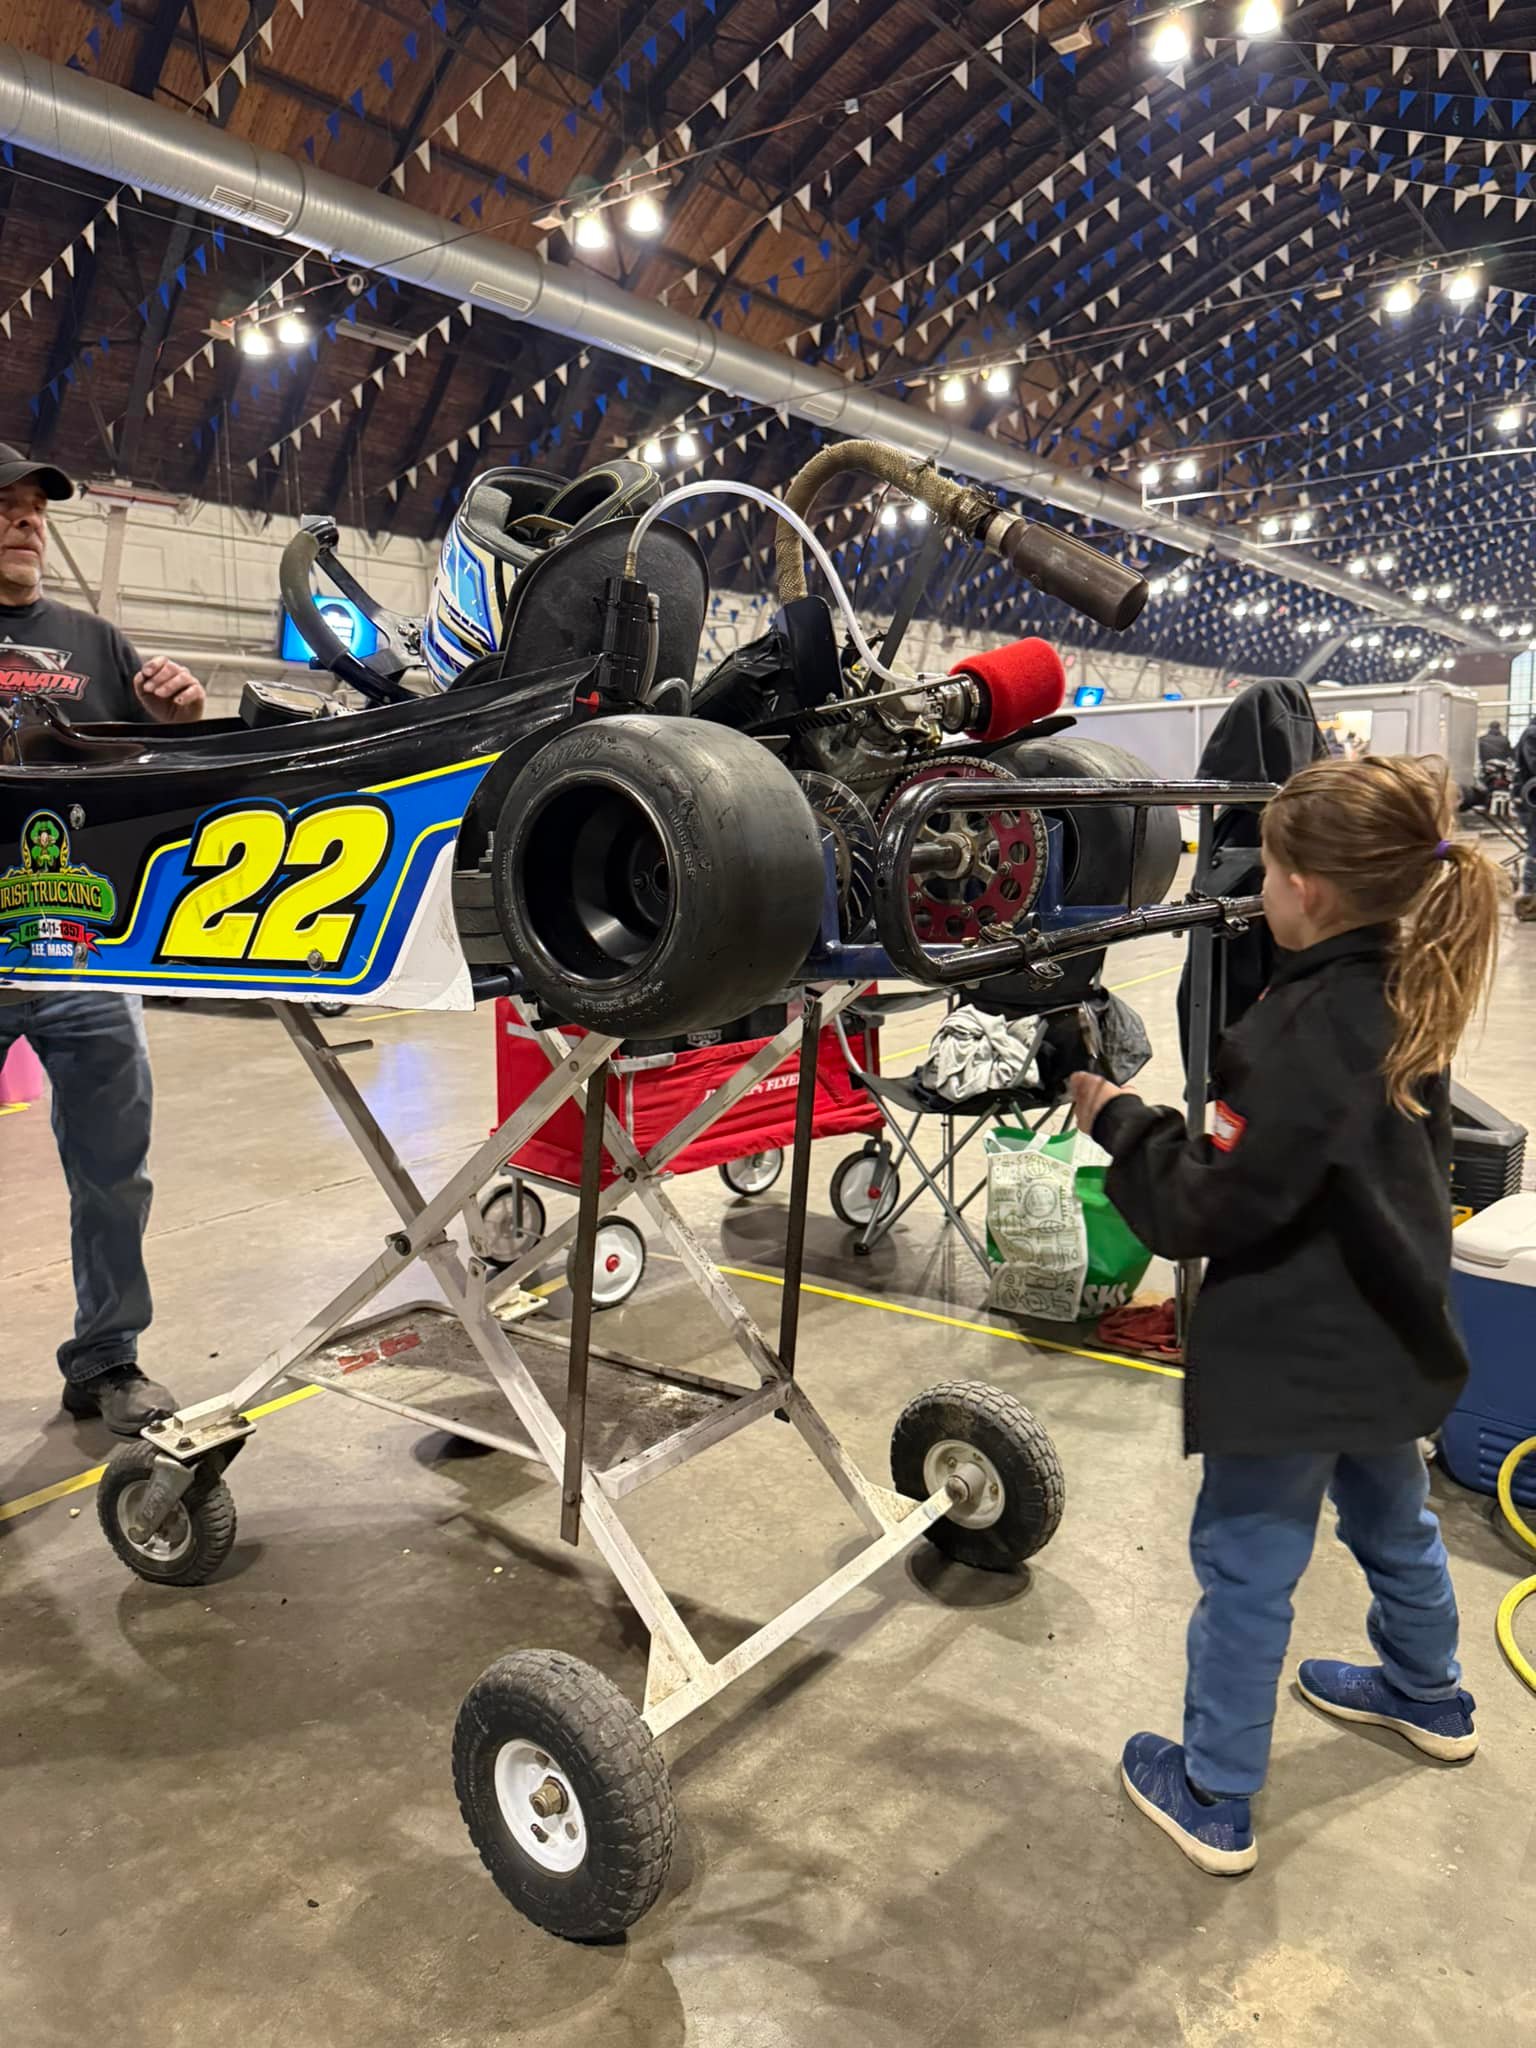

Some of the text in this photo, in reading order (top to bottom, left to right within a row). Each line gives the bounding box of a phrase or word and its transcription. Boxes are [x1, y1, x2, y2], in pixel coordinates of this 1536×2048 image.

[0, 881, 102, 909] IRISH TRUCKING
[157, 801, 391, 966] 22
[47, 943, 73, 957] MASS
